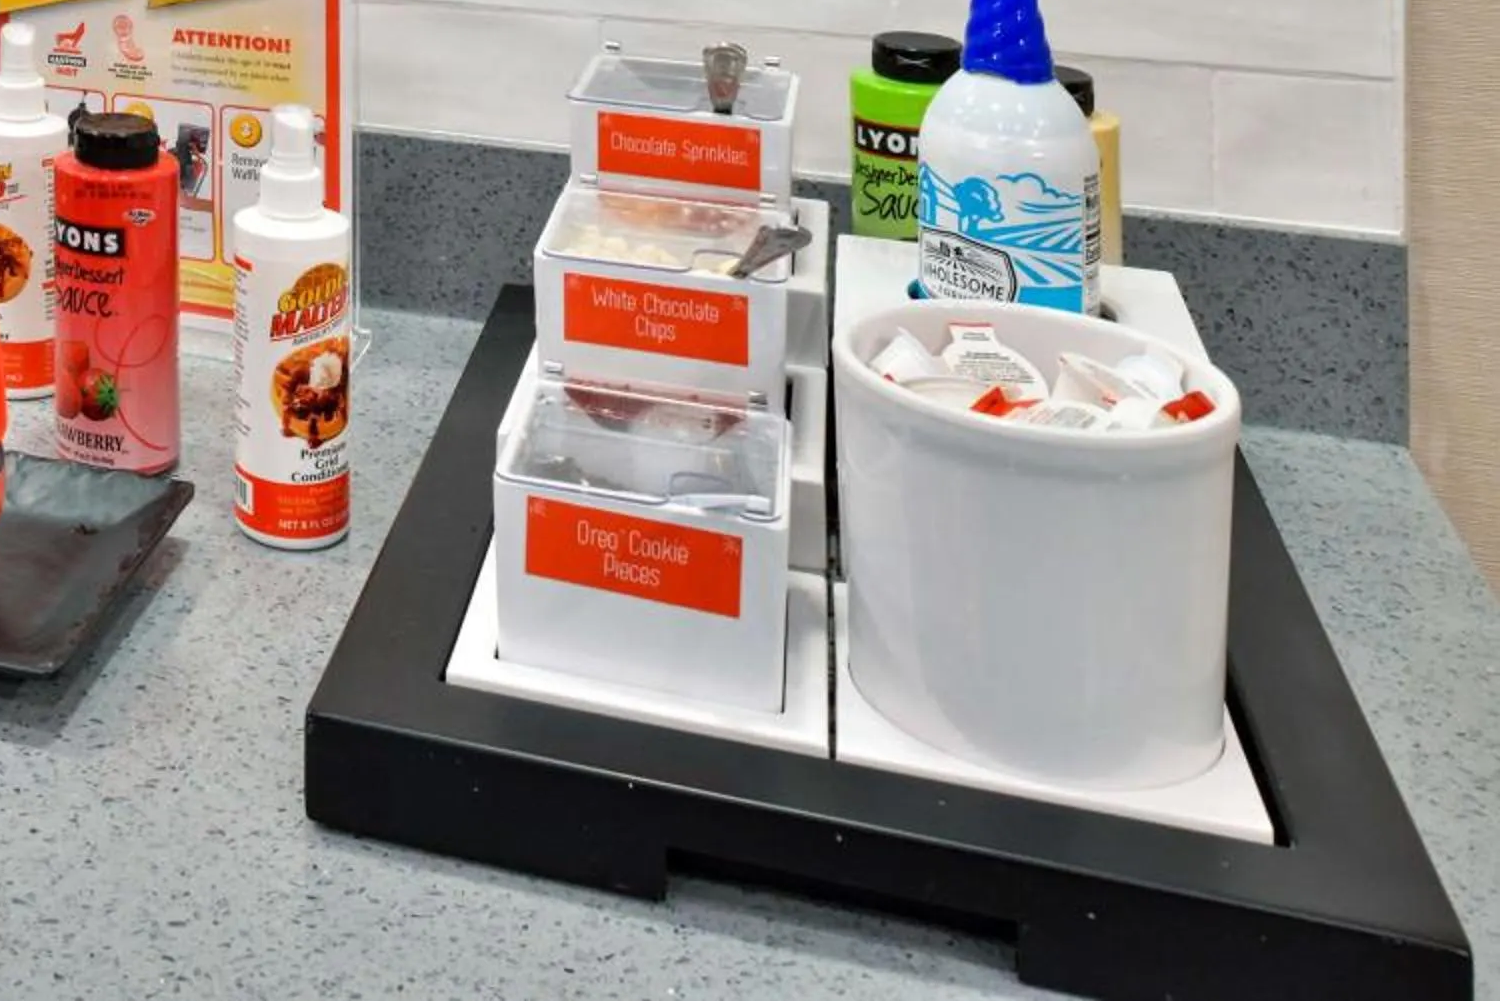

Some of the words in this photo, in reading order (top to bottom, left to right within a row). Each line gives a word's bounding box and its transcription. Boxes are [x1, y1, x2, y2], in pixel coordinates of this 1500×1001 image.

[172, 28, 291, 54] ATTENTION!
[232, 152, 269, 168] Remov
[611, 131, 677, 157] Chocolate
[682, 140, 748, 166] Sprinkles
[232, 167, 261, 181] Waffl
[56, 221, 119, 254] YONS
[592, 284, 636, 310] White
[644, 293, 719, 323] Chocolate
[635, 315, 676, 343] Chips
[576, 519, 619, 552] Oreo
[628, 530, 690, 566] Cookie
[603, 551, 661, 587] Pieces
